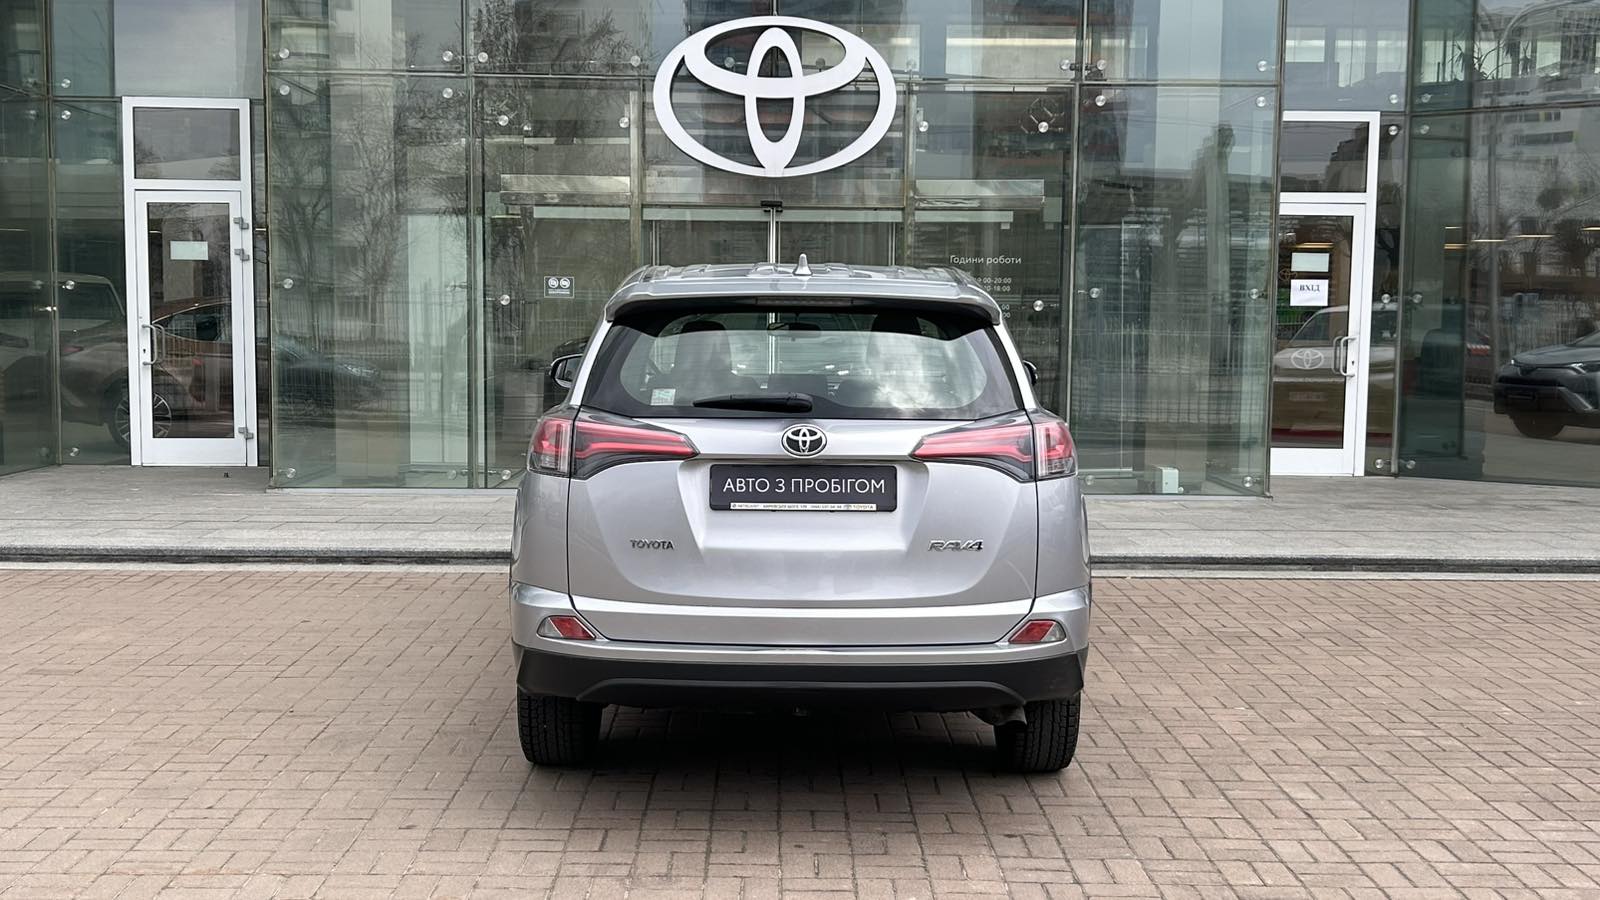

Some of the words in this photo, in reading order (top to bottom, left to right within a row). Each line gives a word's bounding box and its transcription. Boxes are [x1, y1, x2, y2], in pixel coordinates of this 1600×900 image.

[949, 255, 984, 265] Години
[986, 255, 1022, 267] роботи
[1299, 284, 1321, 293] ВХІД
[722, 478, 770, 493] АВТО
[774, 478, 786, 493] З
[791, 478, 886, 494] ПРОБІГОМ
[629, 539, 675, 550] TOYOTA
[928, 539, 984, 552] RAV4
